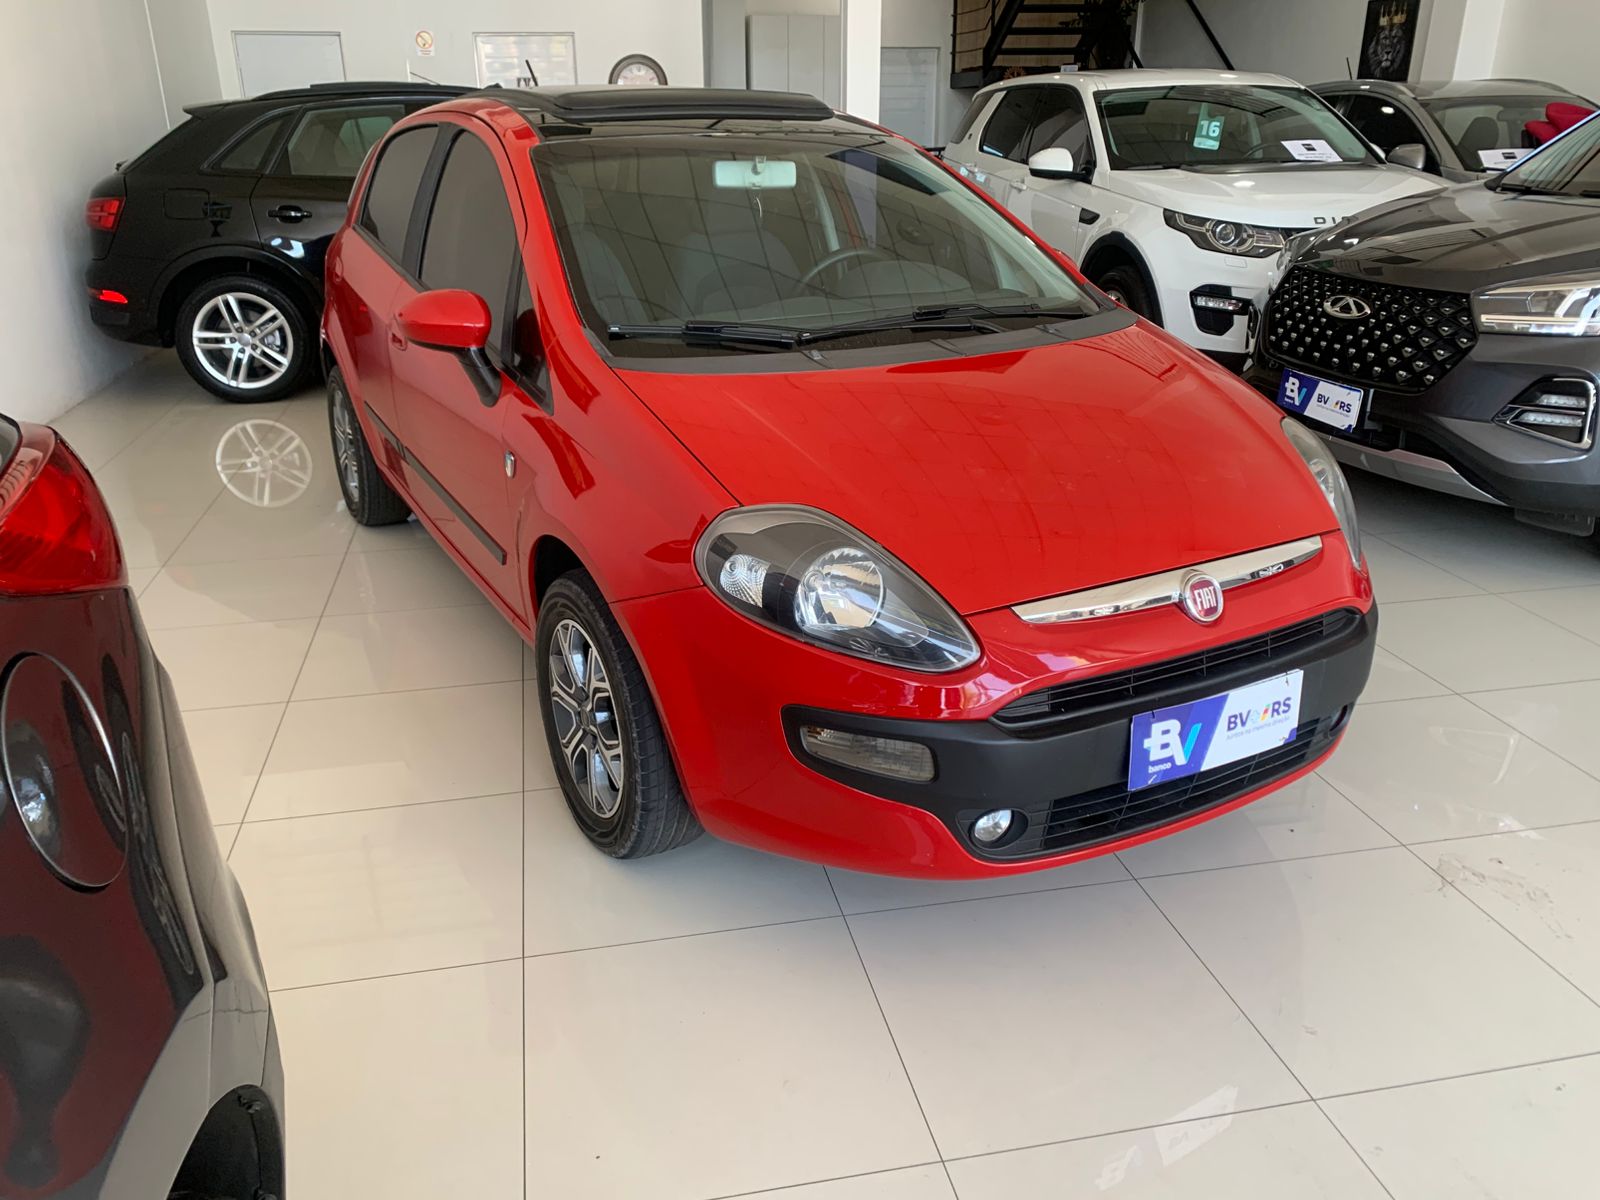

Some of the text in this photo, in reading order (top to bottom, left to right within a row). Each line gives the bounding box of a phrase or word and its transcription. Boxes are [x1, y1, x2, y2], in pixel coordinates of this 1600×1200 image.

[1200, 120, 1220, 137] 16
[1193, 585, 1217, 611] FIAT
[1143, 719, 1202, 766] BV
[1148, 762, 1172, 774] banco
